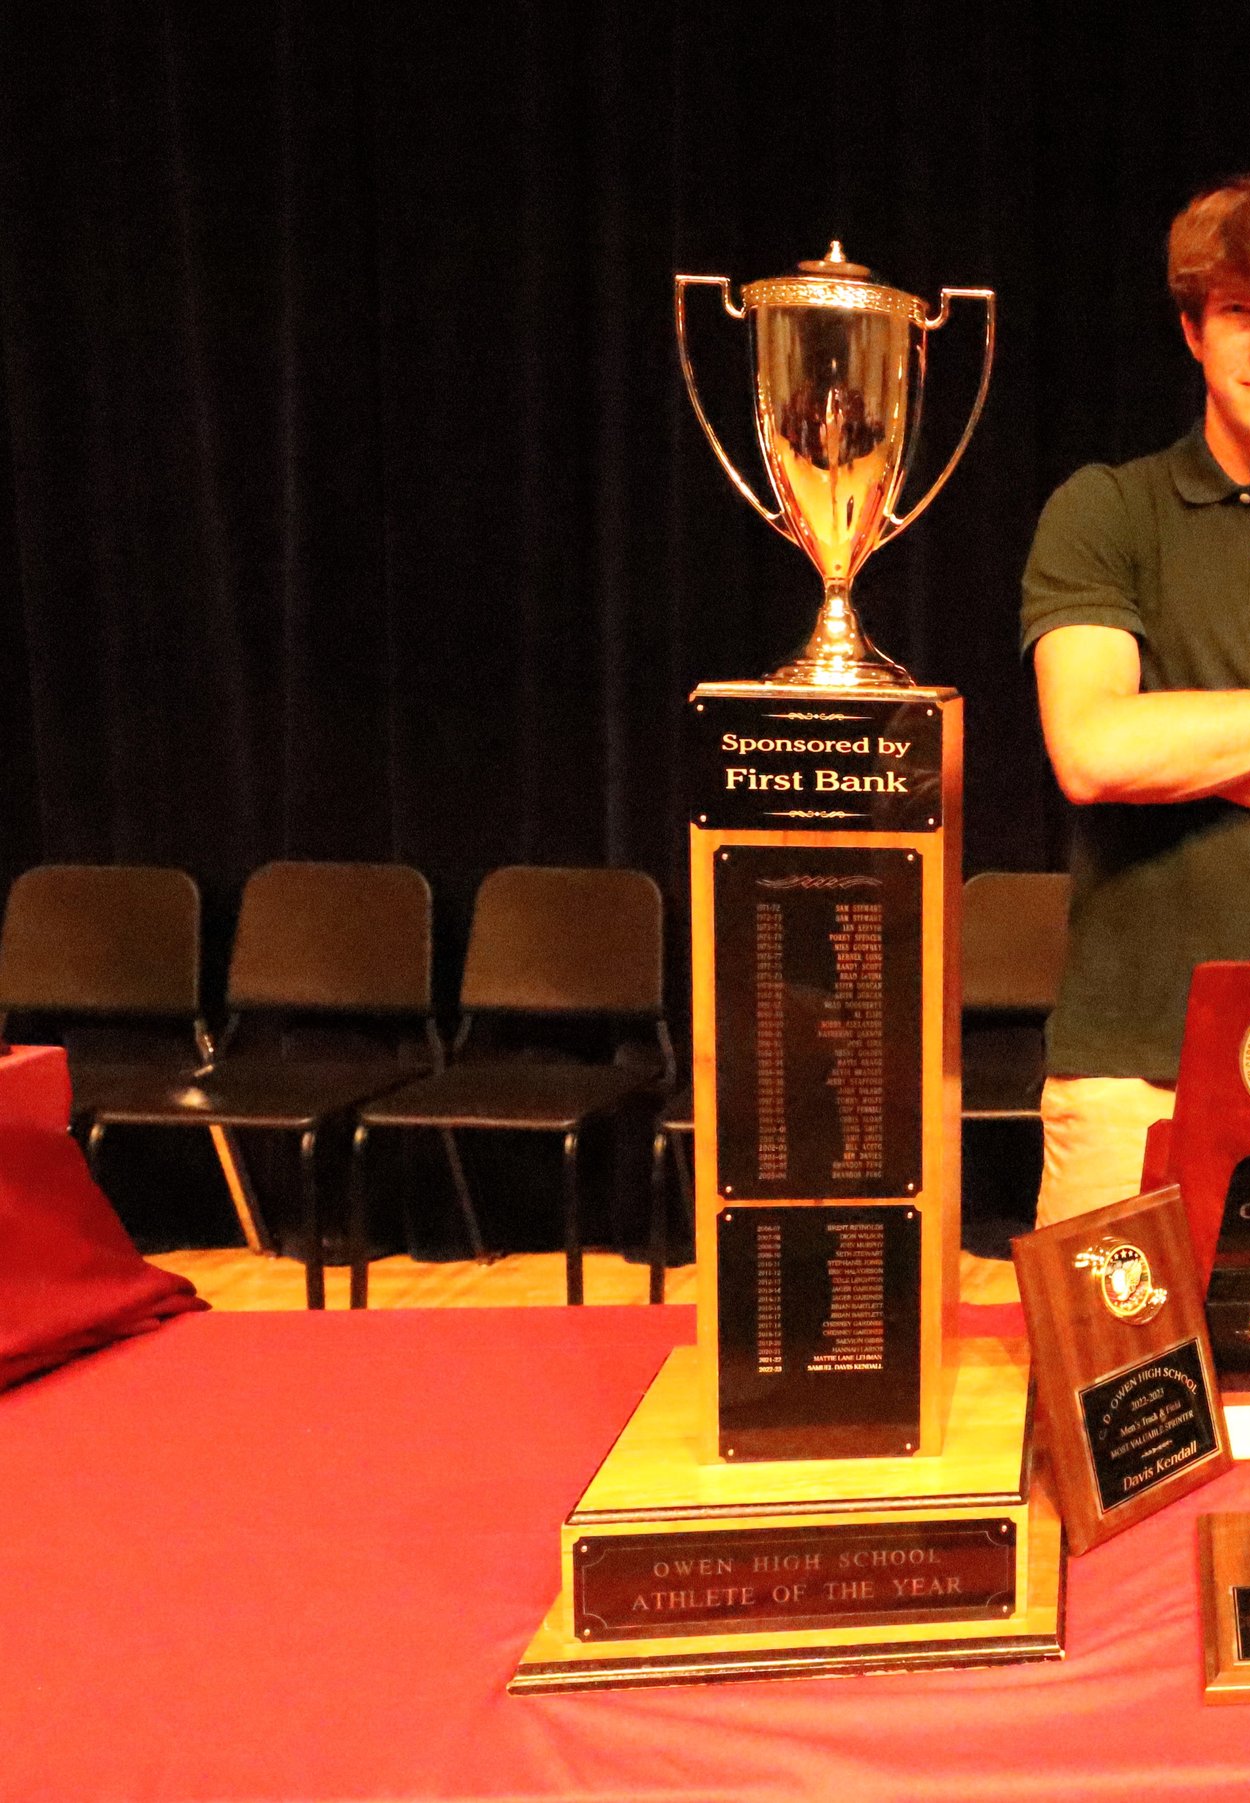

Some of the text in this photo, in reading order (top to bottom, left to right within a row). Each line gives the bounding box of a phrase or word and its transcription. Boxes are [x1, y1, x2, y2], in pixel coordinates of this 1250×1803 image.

[721, 733, 912, 758] Sponsored by
[725, 768, 909, 793] First Bank
[807, 1363, 832, 1372] SAMUEL
[834, 1363, 853, 1372] DAVIS
[853, 1363, 884, 1372] KENDALL
[837, 1354, 854, 1362] LANE
[1110, 1377, 1138, 1409] OWEN
[1137, 1367, 1162, 1383] HIGH
[1162, 1367, 1199, 1396] SCHOOL
[1110, 1409, 1195, 1460] MOST VALUABLE SPRINTER
[1119, 1420, 1141, 1438] Men's
[1158, 1407, 1166, 1418] &
[1123, 1439, 1198, 1492] Davis Kendall
[653, 1548, 942, 1578] OWEN HIGH SCHOOL
[631, 1577, 963, 1612] ATHLETE OF THE YEAR
